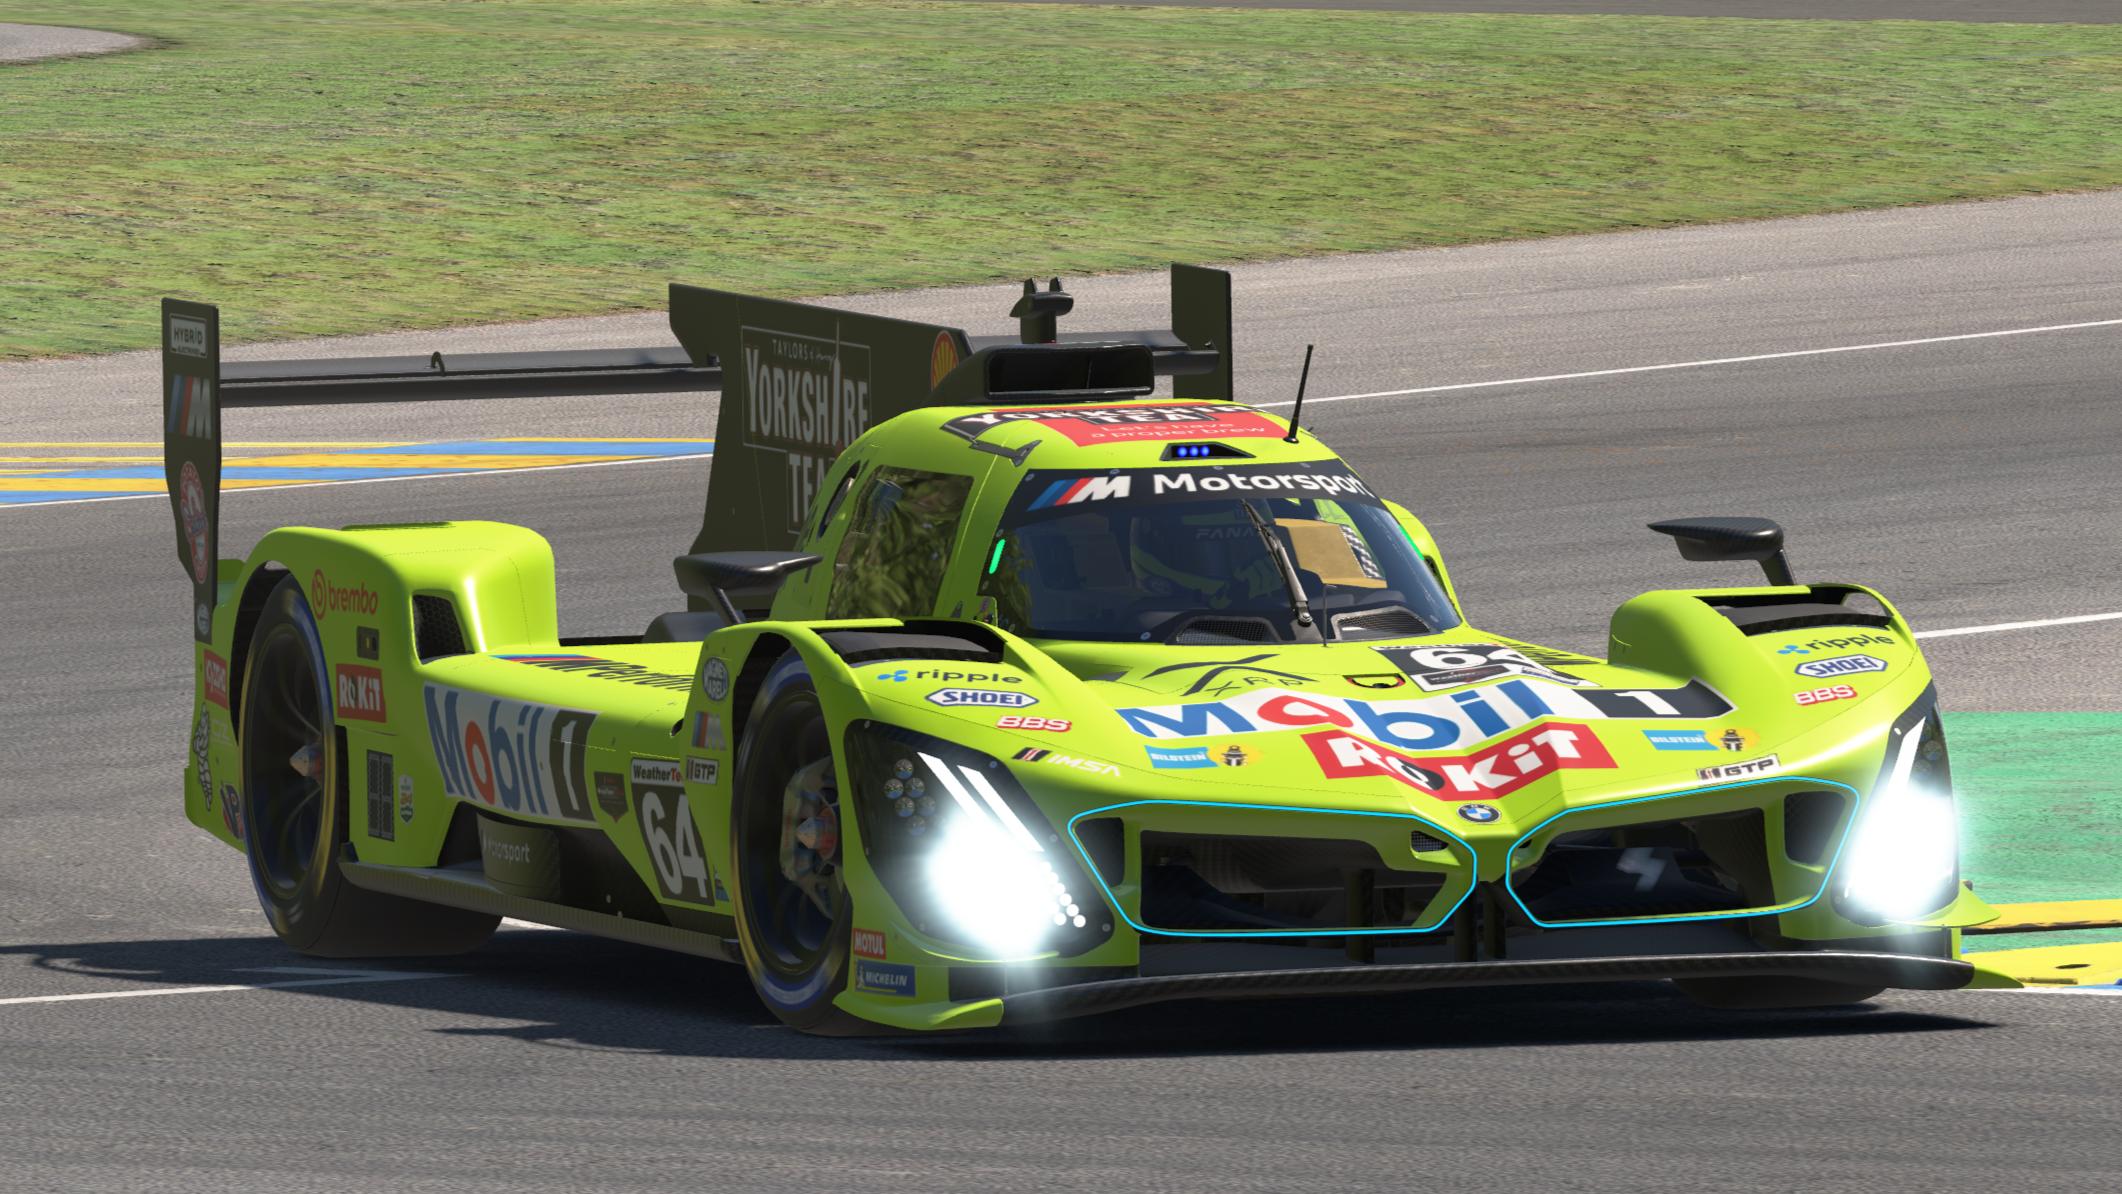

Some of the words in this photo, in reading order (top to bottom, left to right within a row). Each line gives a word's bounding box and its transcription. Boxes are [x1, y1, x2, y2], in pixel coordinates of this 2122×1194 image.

[772, 338, 809, 360] TAYLORS
[745, 347, 868, 449] YORKSHIRE
[961, 405, 1258, 424] YORKSHIR
[1089, 413, 1203, 423] TEA
[1153, 473, 1376, 499] Motorsport
[1195, 526, 1260, 540] FANA
[327, 579, 379, 615] brembo
[1805, 633, 1895, 650] ripple
[916, 668, 1023, 683] ripple
[1807, 657, 1878, 675] SHOEI
[942, 691, 1024, 704] SHOEI
[1793, 684, 1858, 706] BBS
[997, 714, 1073, 732] BBS
[1115, 679, 1556, 750] Mobil
[1613, 690, 1682, 715] 1
[424, 685, 548, 816] Mobil
[560, 719, 580, 811] 1
[1150, 752, 1207, 763] BILSTEIN
[633, 764, 683, 782] WeatherTe
[693, 763, 715, 782] GTP
[1047, 753, 1122, 777] IMSA
[1724, 758, 1774, 776] GTP
[642, 791, 708, 899] 64
[854, 931, 884, 956] MOTUL
[865, 970, 908, 987] MICHELIN
